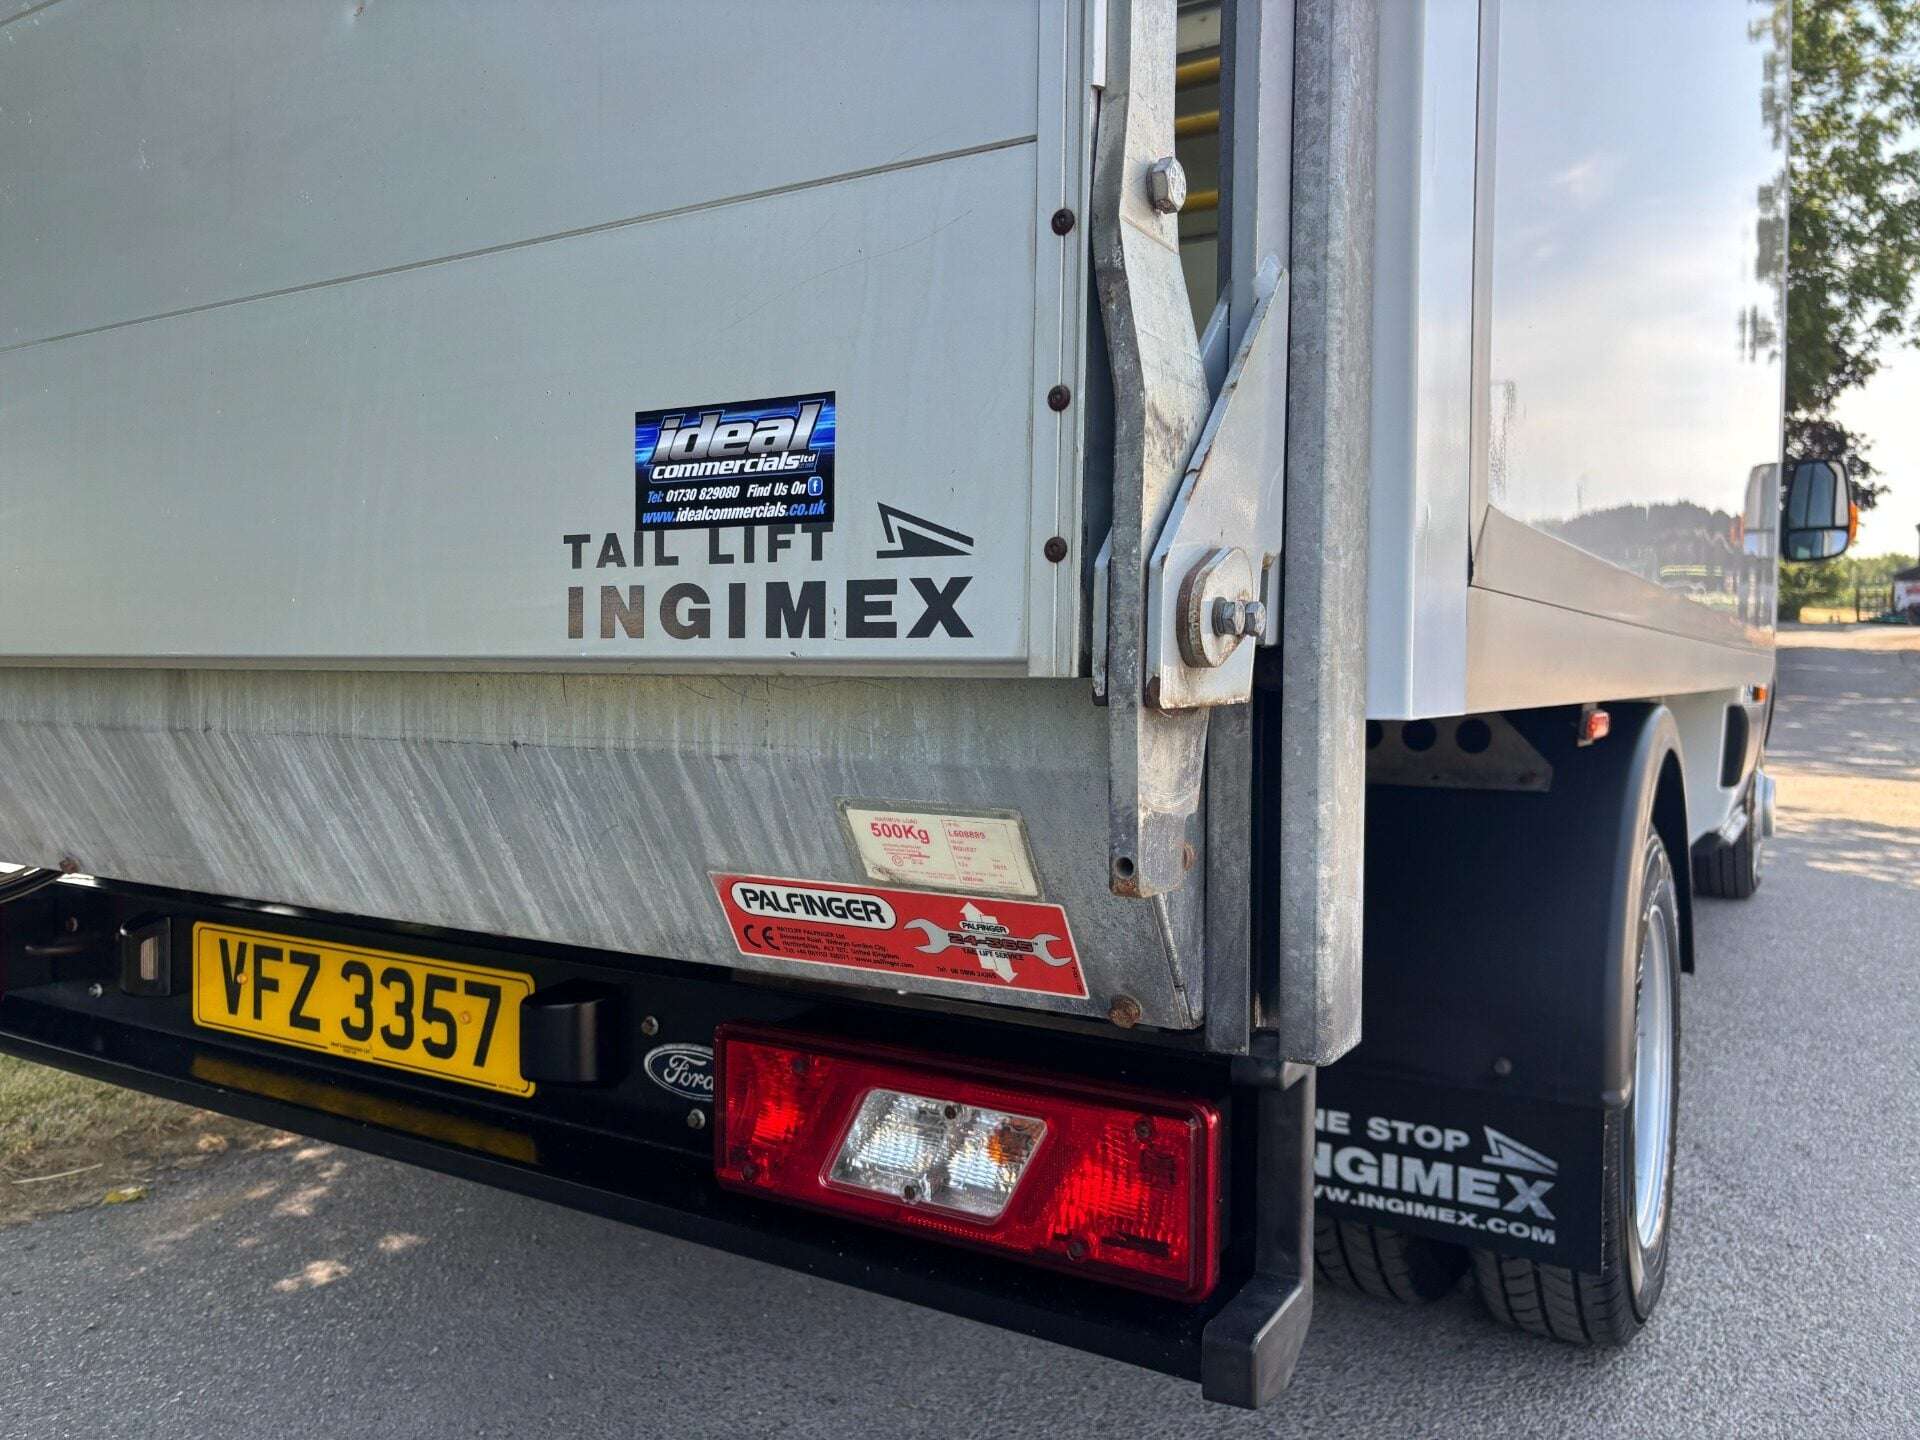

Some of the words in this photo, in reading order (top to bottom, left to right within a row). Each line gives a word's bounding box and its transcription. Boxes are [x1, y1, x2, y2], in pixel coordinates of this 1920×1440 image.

[650, 402, 821, 463] ideal
[651, 451, 800, 480] commercials
[647, 490, 664, 503] Tel:
[666, 487, 695, 503] 01730
[699, 485, 740, 501] 829080
[747, 483, 770, 498] Find
[774, 482, 788, 496] Us
[791, 481, 806, 495] On
[642, 500, 826, 524] www.idealcommercials.co.uk
[563, 529, 679, 569] TAIL
[709, 522, 834, 565] LIFT
[568, 576, 975, 640] INGIMEX
[870, 822, 930, 845] 500Kg
[739, 887, 886, 924] PALFINGER
[961, 921, 1007, 934] PALFINGER
[219, 937, 321, 1033] VFZ
[340, 959, 502, 1068] 3357
[1366, 1116, 1470, 1153] STOP
